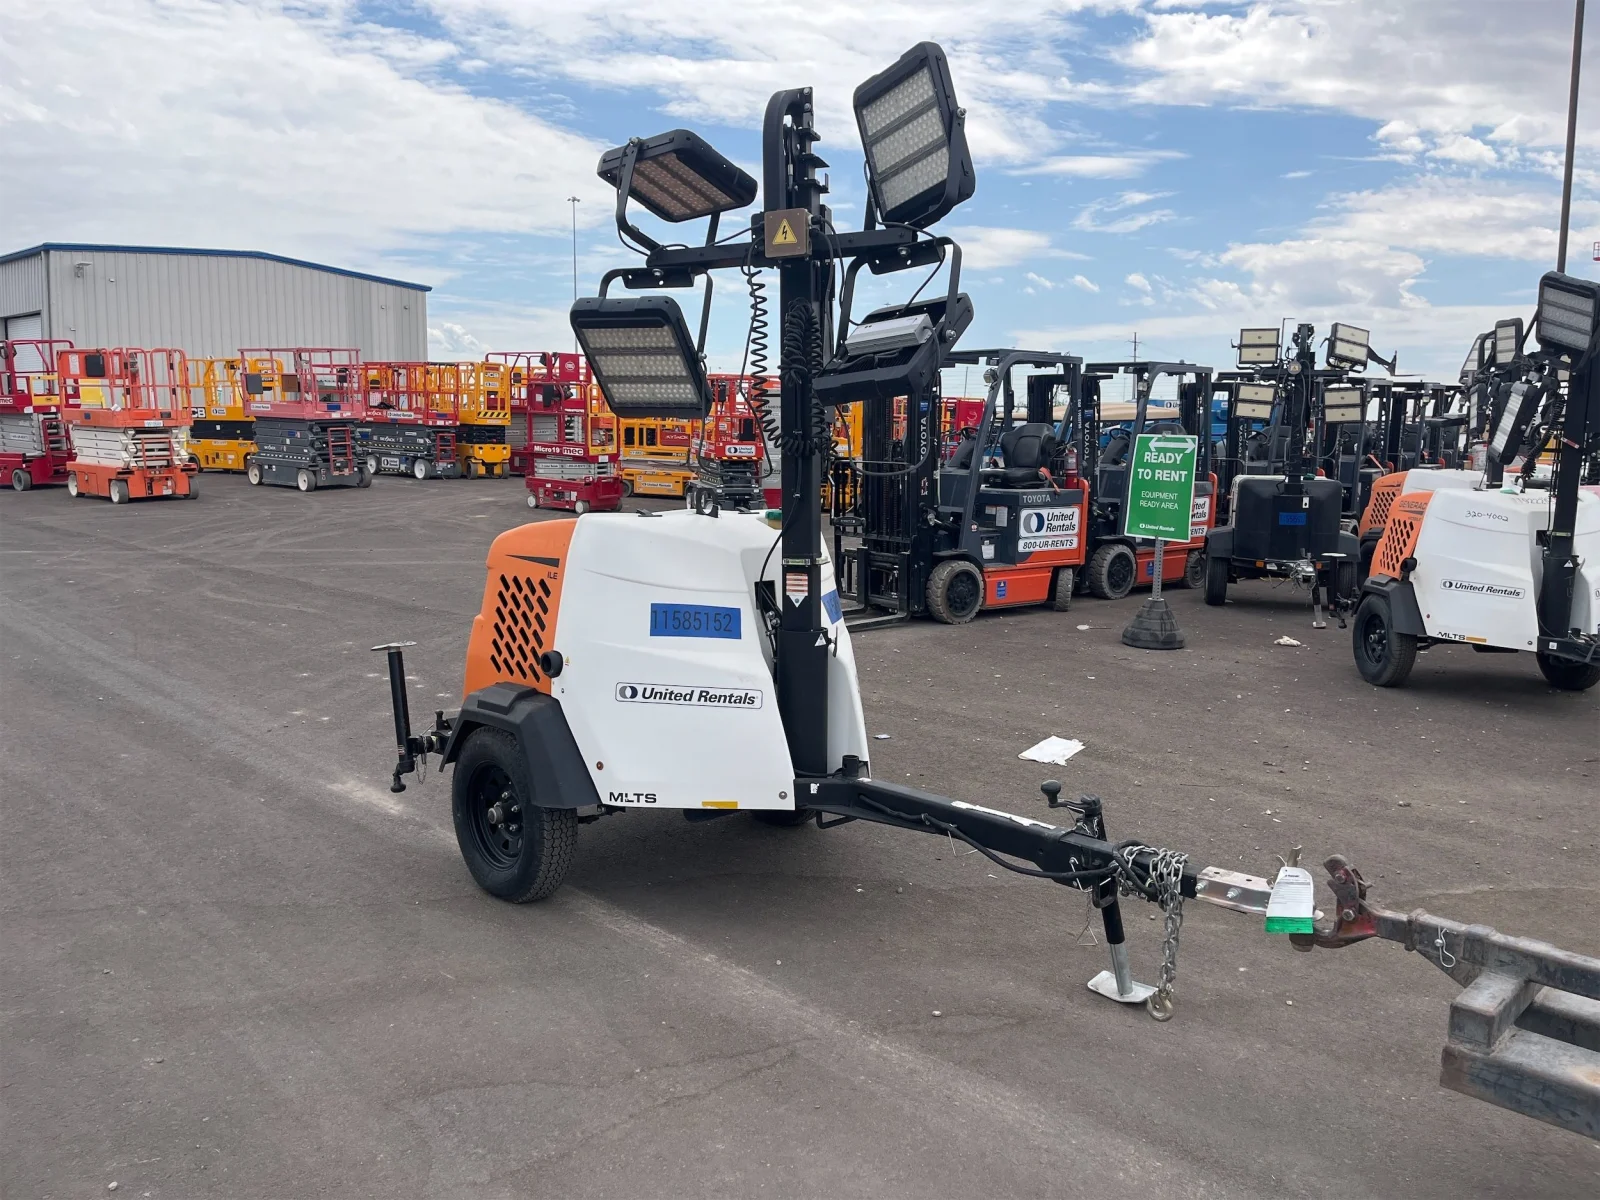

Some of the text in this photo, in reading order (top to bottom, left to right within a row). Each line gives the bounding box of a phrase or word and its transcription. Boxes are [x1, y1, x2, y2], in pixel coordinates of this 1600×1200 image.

[191, 407, 206, 418] CB
[563, 447, 583, 455] mec
[1143, 451, 1183, 464] READY
[1137, 468, 1188, 482] TO RENT
[1022, 494, 1051, 503] TOYOTA
[1141, 490, 1178, 500] EQUIPMENT
[1140, 500, 1179, 510] READY AREA
[1193, 500, 1206, 510] ited
[1046, 511, 1075, 522] United
[1192, 510, 1207, 519] ntals
[1464, 510, 1509, 522] 320-4002
[1045, 522, 1076, 532] Rentals
[1022, 539, 1074, 549] 800-UR-RENTS
[1454, 582, 1521, 597] United Rentals
[651, 609, 733, 632] 11585152
[1436, 631, 1466, 641] MLTS
[641, 687, 756, 705] United Rentals
[609, 791, 657, 803] MLTS
